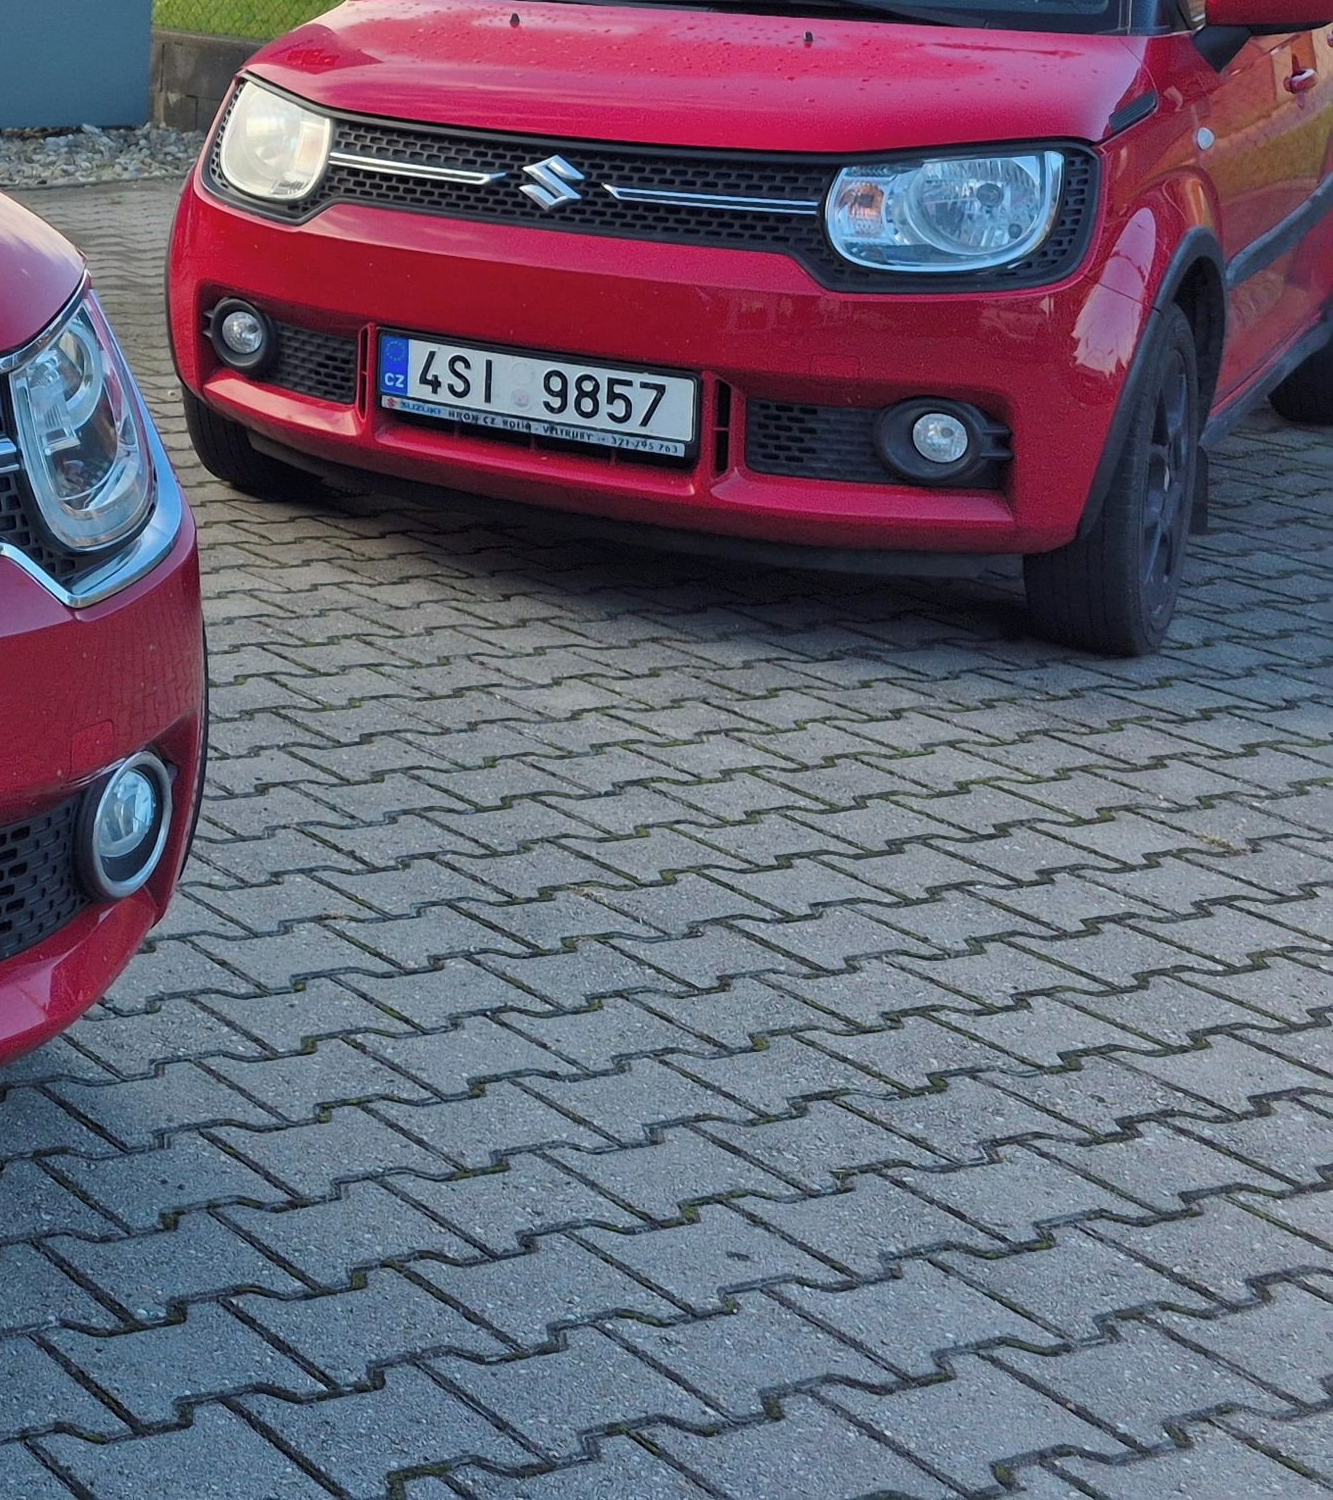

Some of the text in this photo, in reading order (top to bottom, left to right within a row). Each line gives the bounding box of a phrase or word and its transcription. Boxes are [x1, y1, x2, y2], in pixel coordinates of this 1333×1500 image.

[383, 372, 405, 388] CZ
[542, 369, 667, 428] 9857
[400, 401, 442, 415] SUZUKI
[448, 408, 479, 423] HRON
[483, 416, 496, 425] CZ
